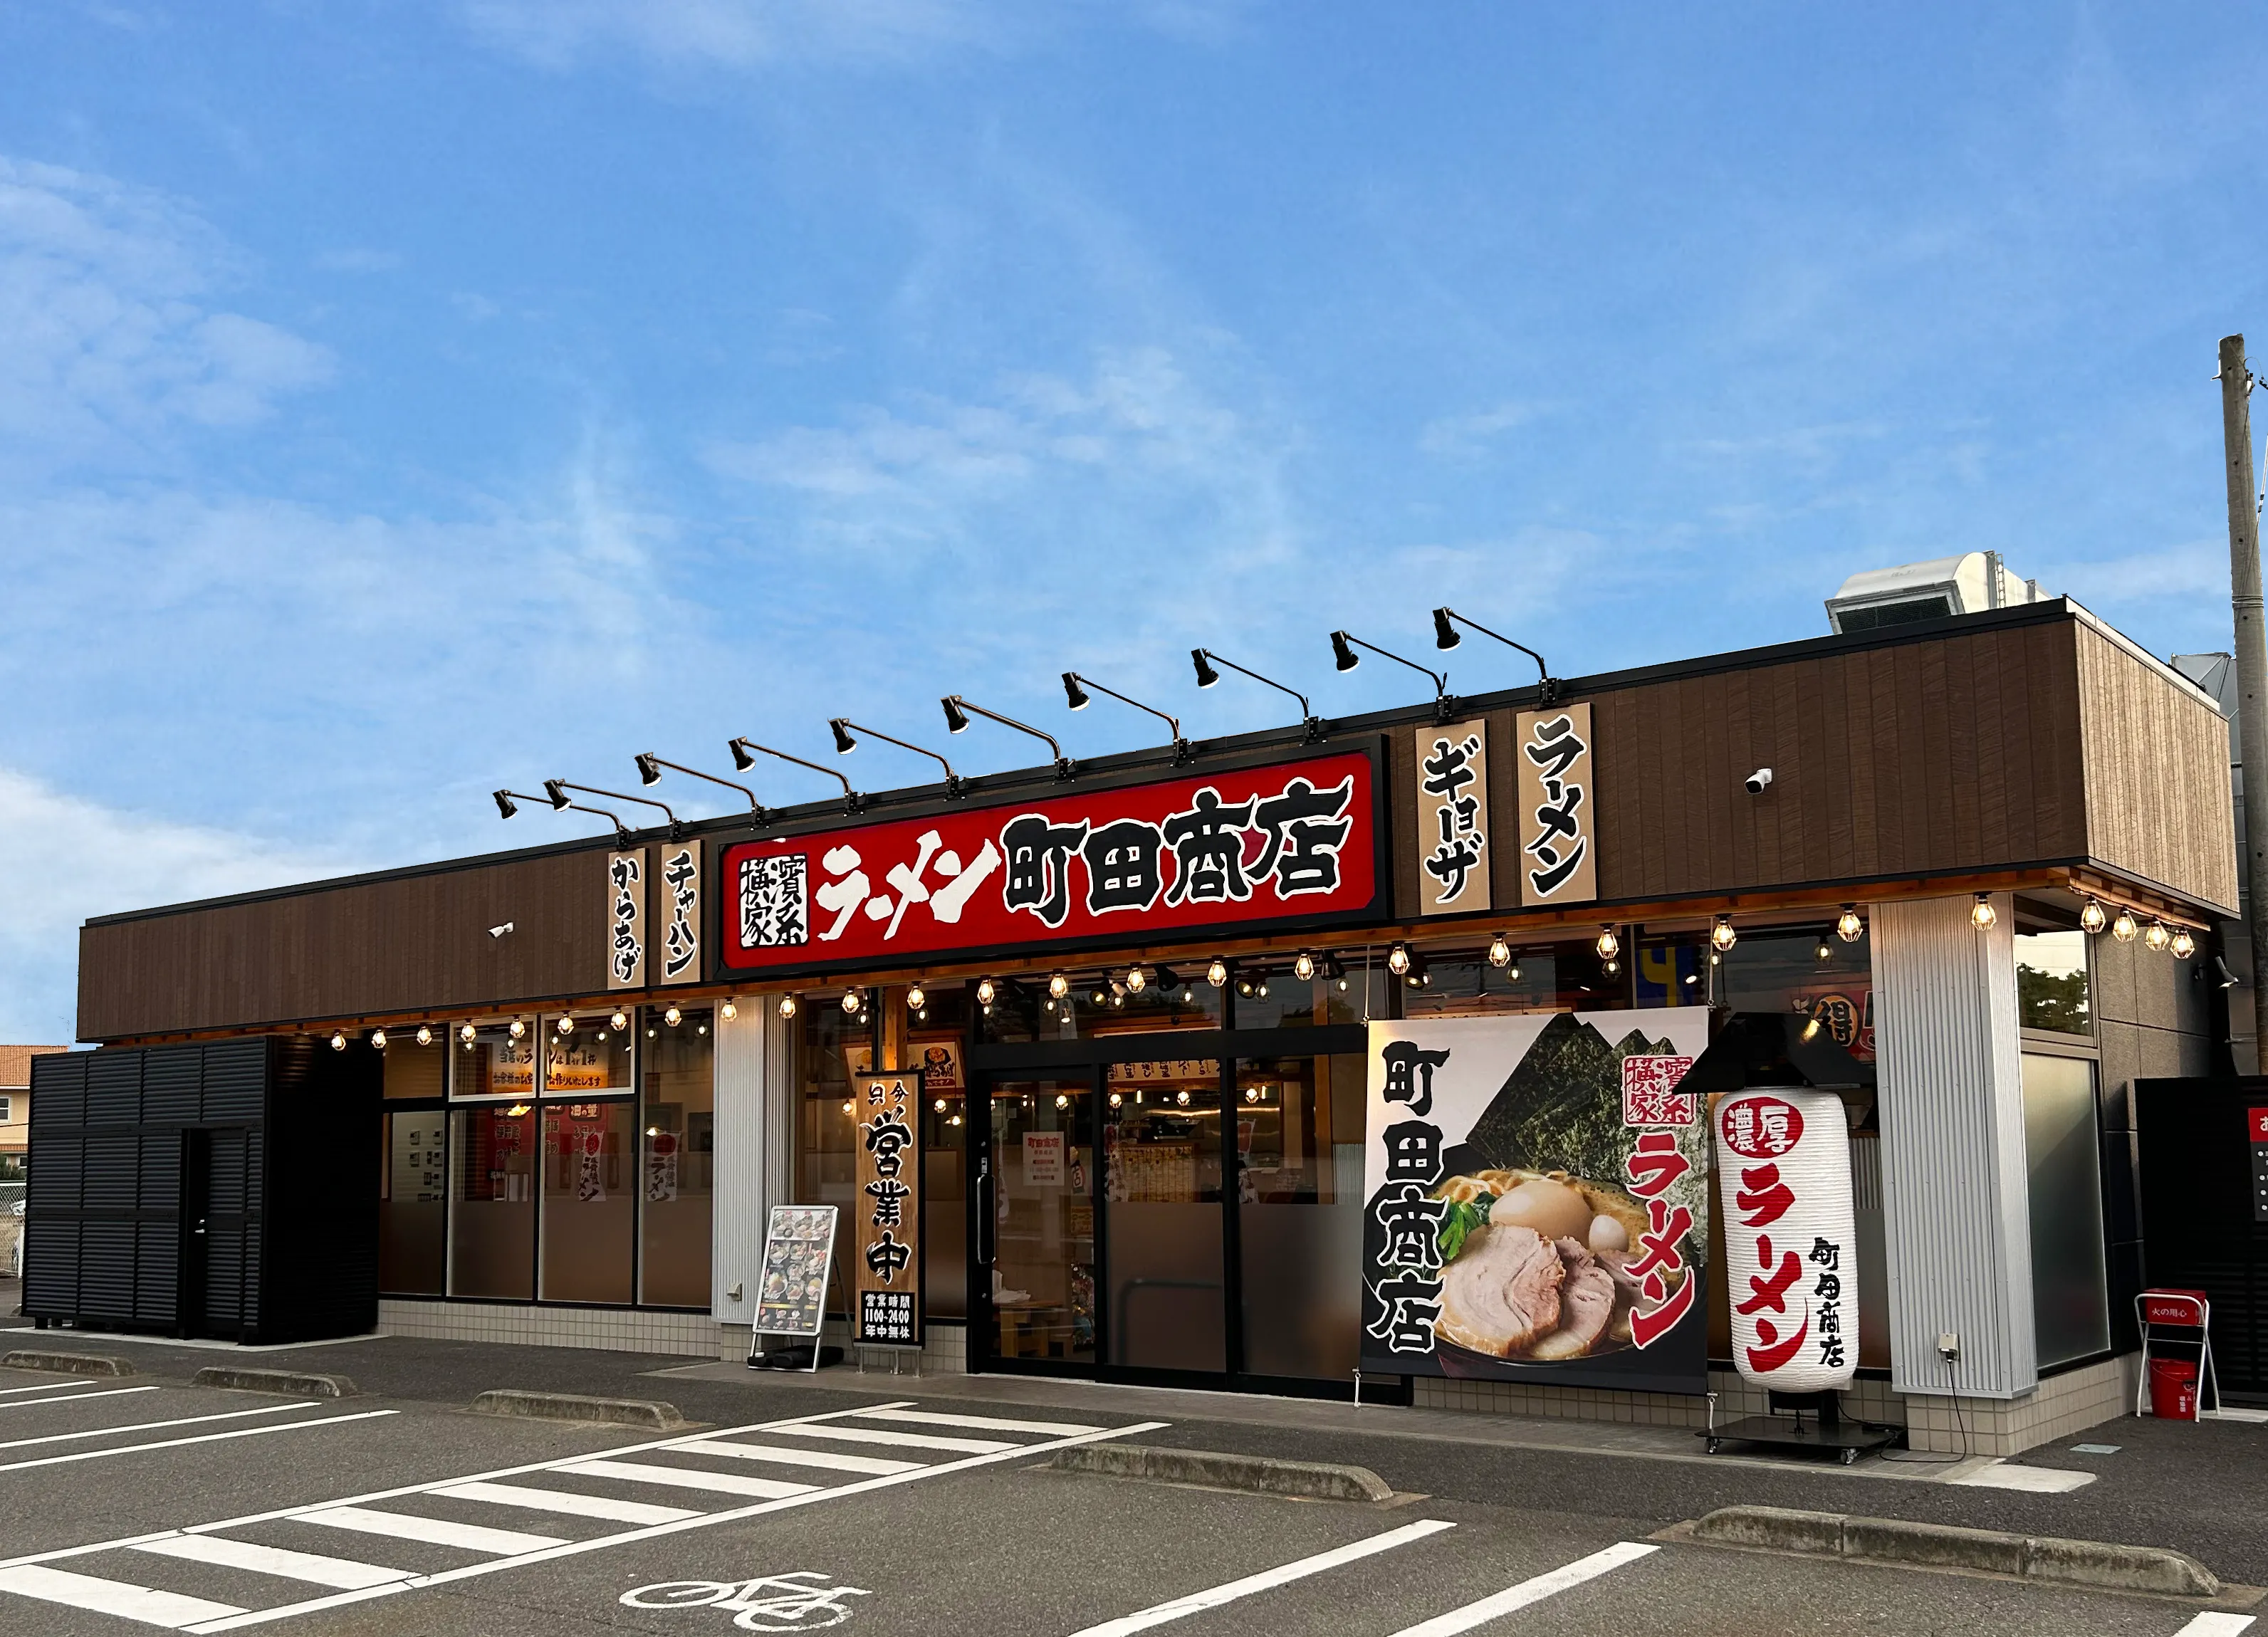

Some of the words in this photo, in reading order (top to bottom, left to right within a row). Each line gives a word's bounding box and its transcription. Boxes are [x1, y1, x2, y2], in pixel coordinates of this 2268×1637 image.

[815, 830, 1001, 940] ラーメン
[999, 775, 1354, 929] 町田商店
[1422, 734, 1485, 904] ギョーザ
[1524, 713, 1587, 898] ラーメン
[610, 856, 642, 983] からあげ
[663, 848, 698, 979] チャーハン
[867, 1079, 909, 1106] 只今
[1728, 1102, 1794, 1154] 濃厚
[859, 1104, 914, 1285] 営業中
[1366, 1040, 1451, 1353] 町田商店
[1621, 1131, 1694, 1349] ラーメン
[865, 1293, 910, 1309] 営業時間
[865, 1324, 910, 1339] 年中無休
[1735, 1163, 1809, 1373] ラーメン
[1808, 1237, 1845, 1368] 町田商店
[2152, 1307, 2188, 1317] 火の用心
